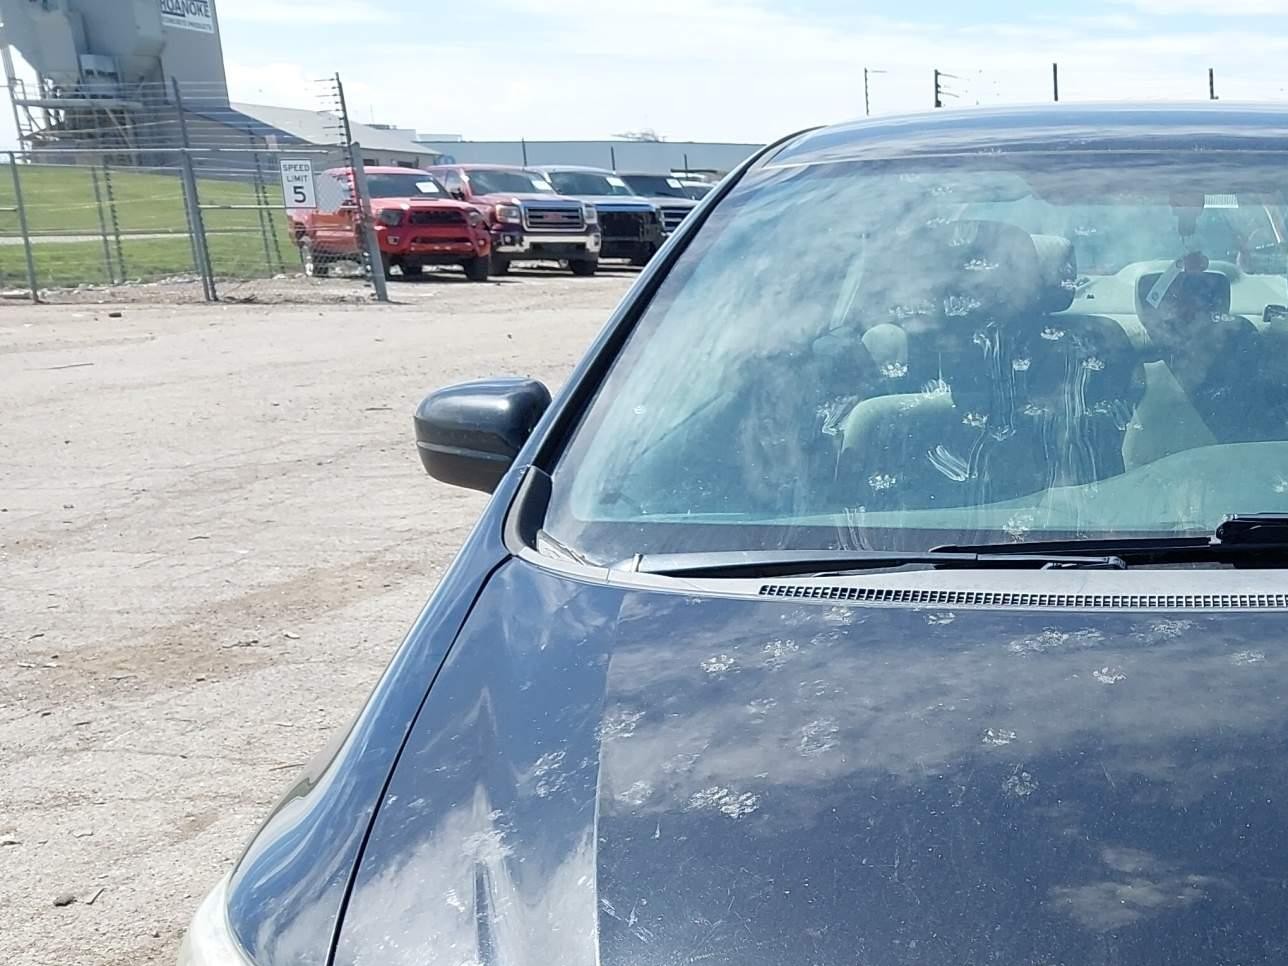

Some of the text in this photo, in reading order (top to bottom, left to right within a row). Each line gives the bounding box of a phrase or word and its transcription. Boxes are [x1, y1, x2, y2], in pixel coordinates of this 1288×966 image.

[282, 164, 310, 172] SPEED
[286, 174, 308, 183] LIMIT
[293, 185, 307, 204] 5
